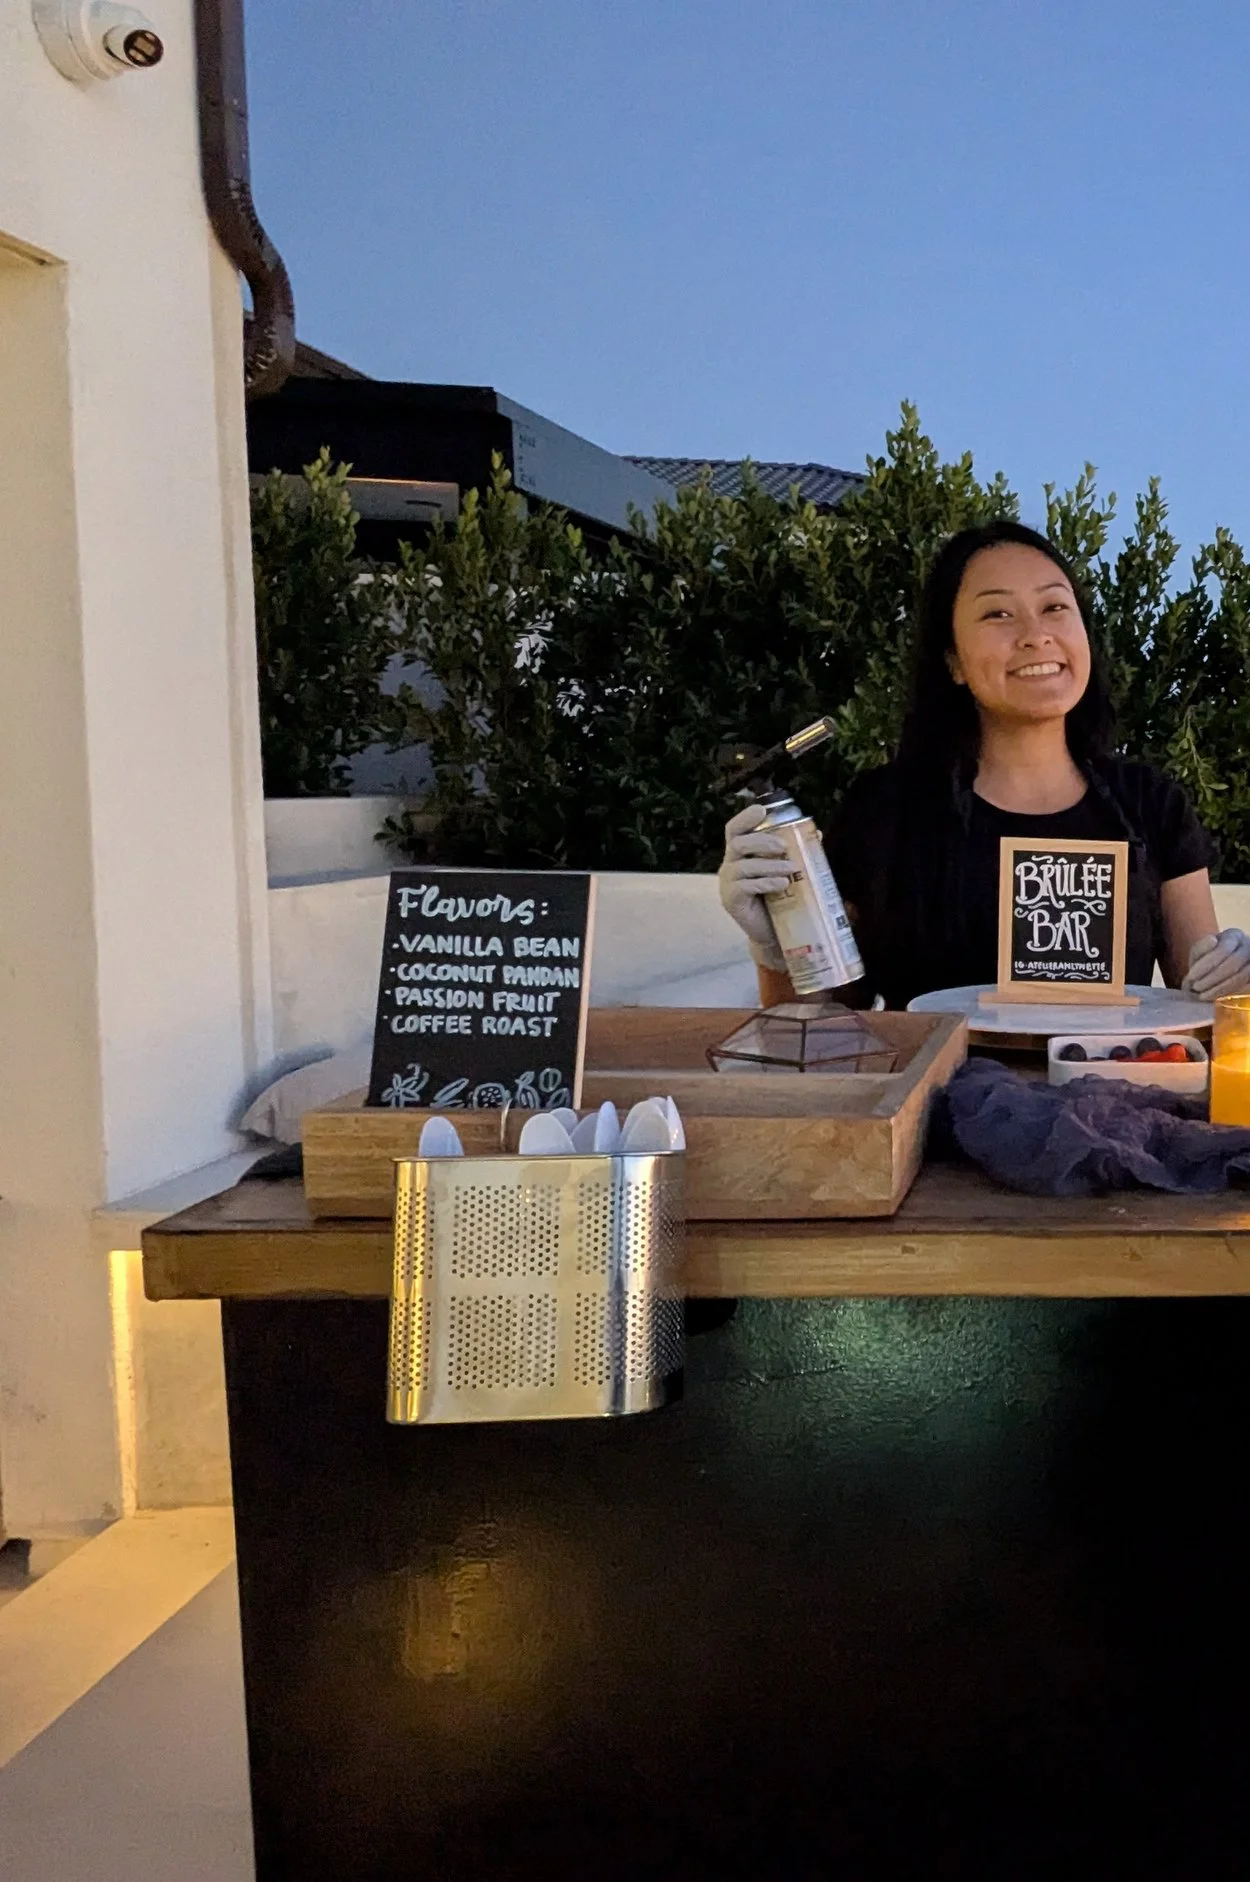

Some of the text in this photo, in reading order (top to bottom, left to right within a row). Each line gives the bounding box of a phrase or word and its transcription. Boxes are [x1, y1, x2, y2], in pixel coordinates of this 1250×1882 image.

[1015, 855, 1112, 908] BRÛLÉE
[397, 884, 549, 925] Flavors:
[400, 934, 580, 959] VANILLA BEAN
[1027, 909, 1100, 958] BAR
[397, 963, 580, 988] COCONUT PANDAN
[395, 986, 561, 1013] PASSION FRUIT
[390, 1014, 559, 1038] COFFEE ROAST
